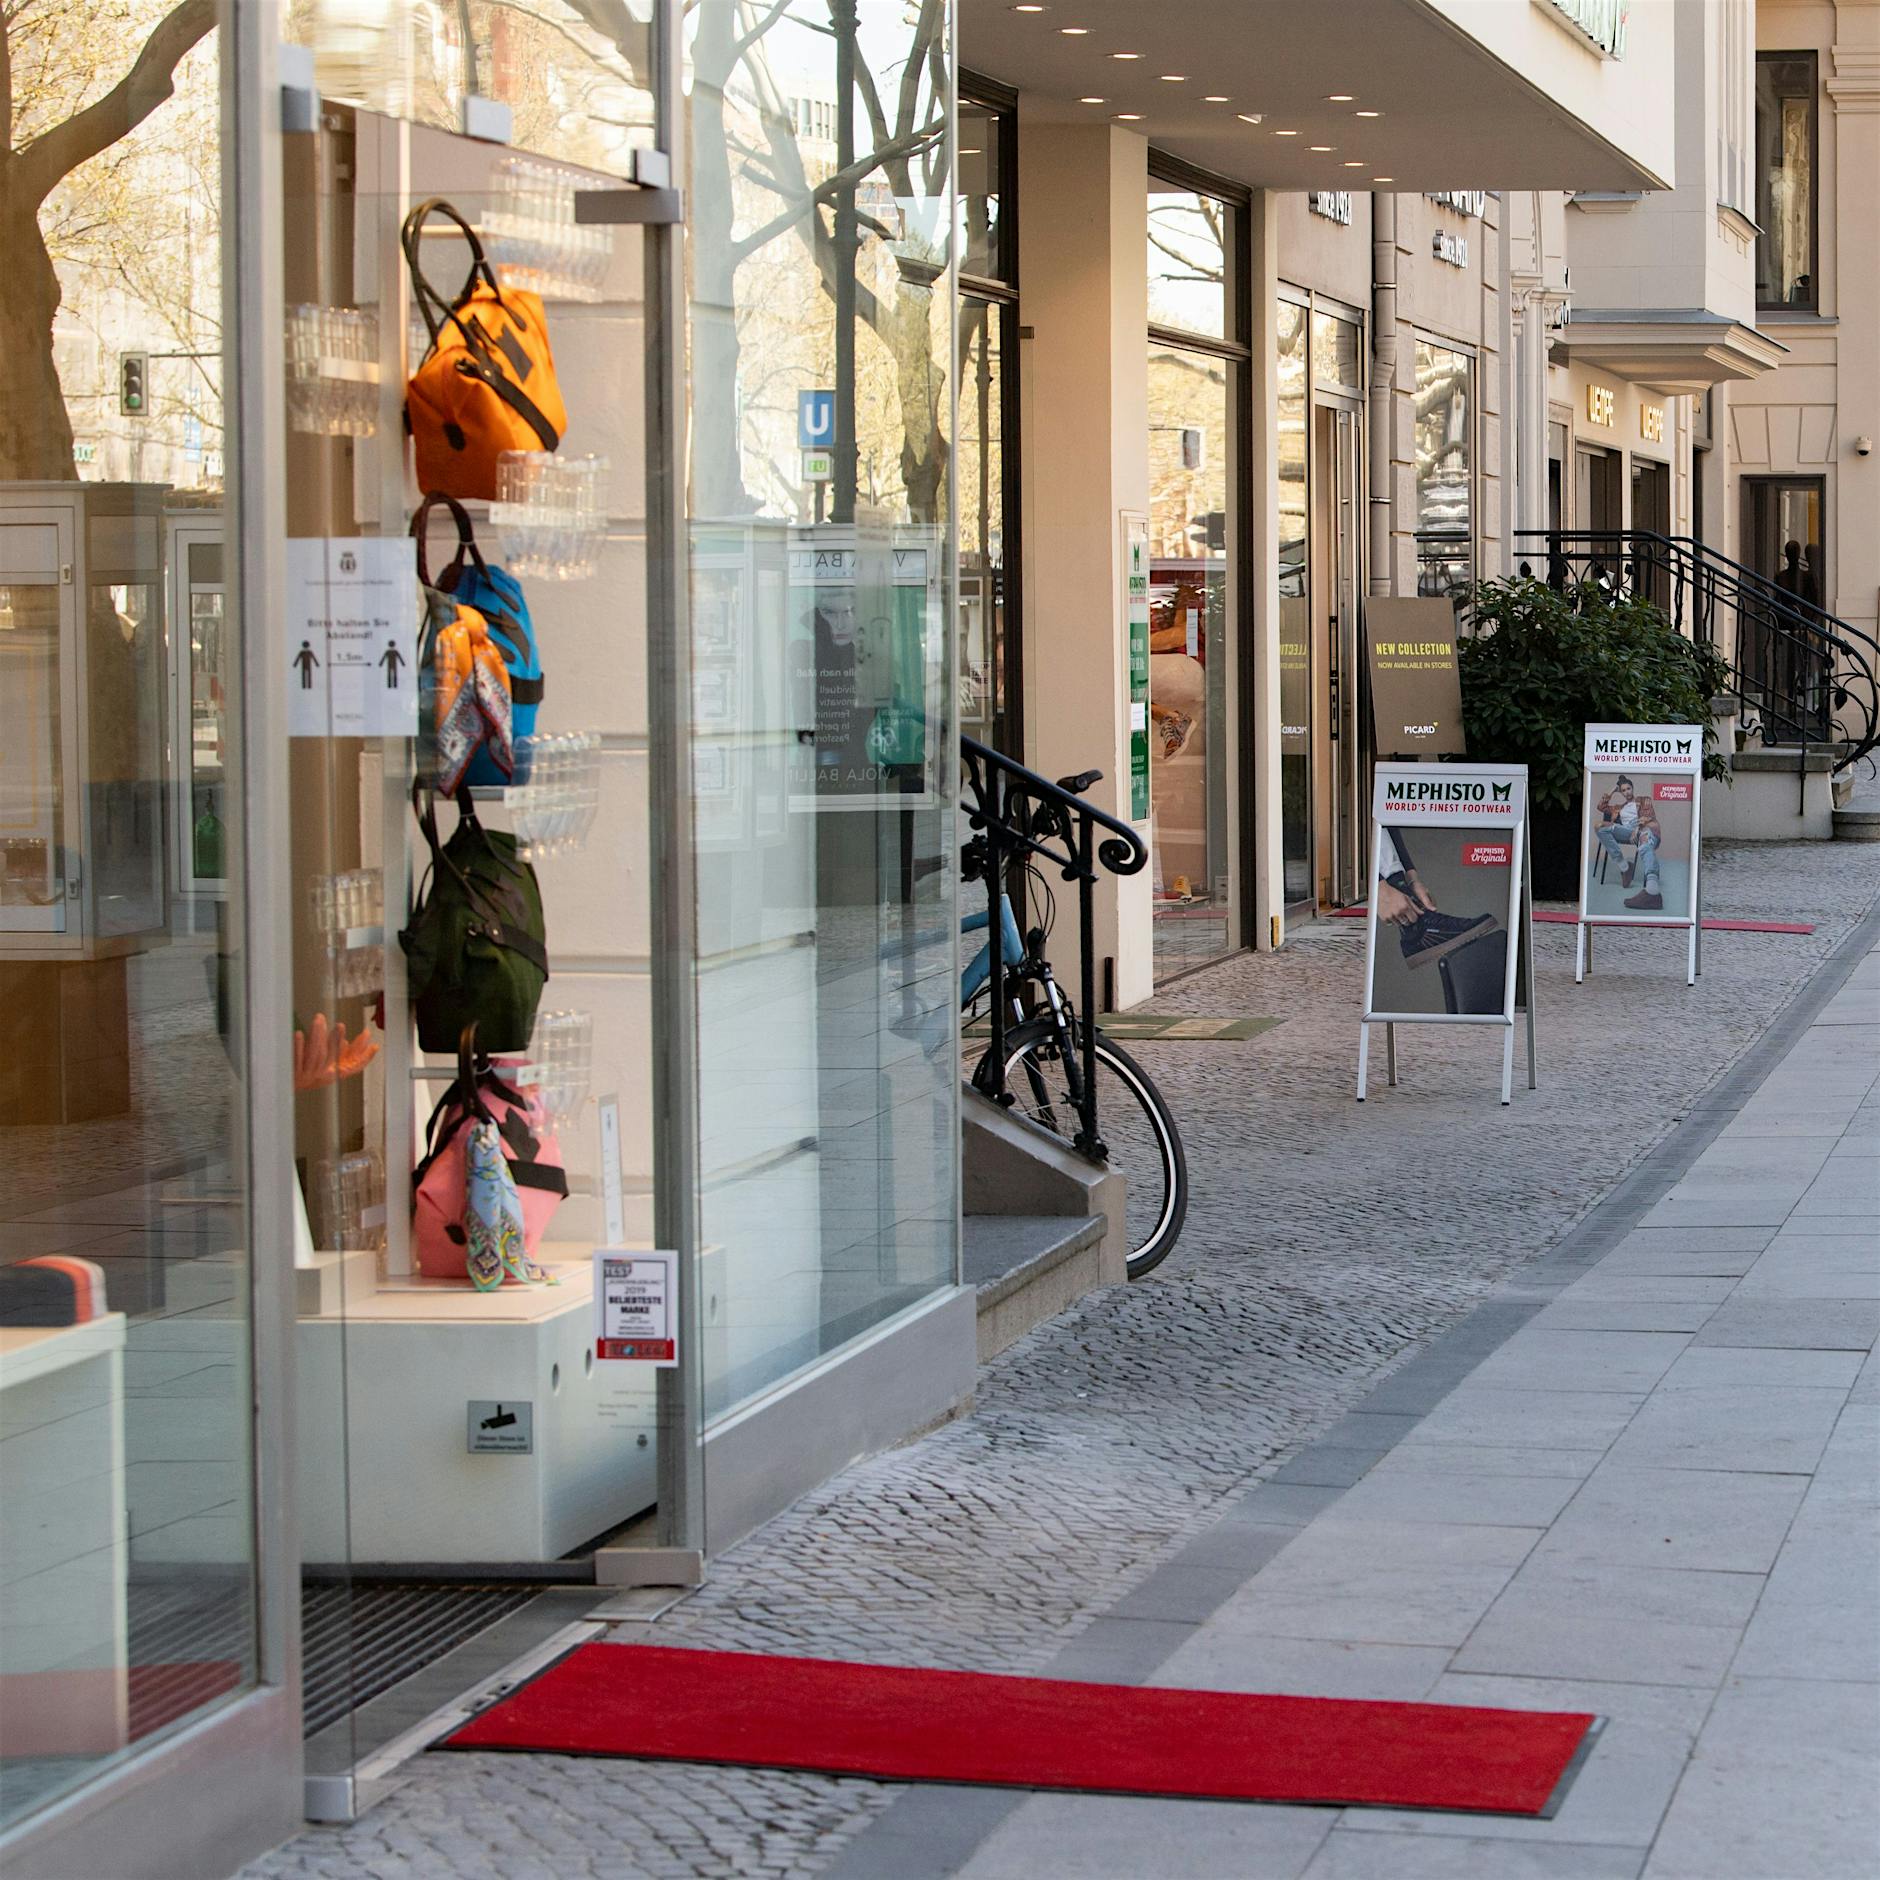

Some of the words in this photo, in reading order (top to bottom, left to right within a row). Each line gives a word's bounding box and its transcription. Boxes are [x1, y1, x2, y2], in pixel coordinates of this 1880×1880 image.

[1376, 643, 1396, 655] NEW
[1398, 643, 1452, 655] COLLECTION
[1404, 725, 1436, 735] PICARD
[1595, 739, 1671, 754] MEPHISTO
[1594, 754, 1626, 762] WORLD'S
[1628, 755, 1651, 763] FINEST
[1654, 755, 1692, 763] FOOTWEAR
[1387, 781, 1486, 801] MEPHISTO
[1385, 802, 1426, 812] WORLD'S
[1429, 803, 1459, 812] FINEST
[1462, 804, 1512, 813] FOOTWEAR
[1473, 847, 1505, 855] MEPHISTO
[1471, 852, 1507, 864] Originals
[608, 1296, 662, 1305] BELIEBTESTE
